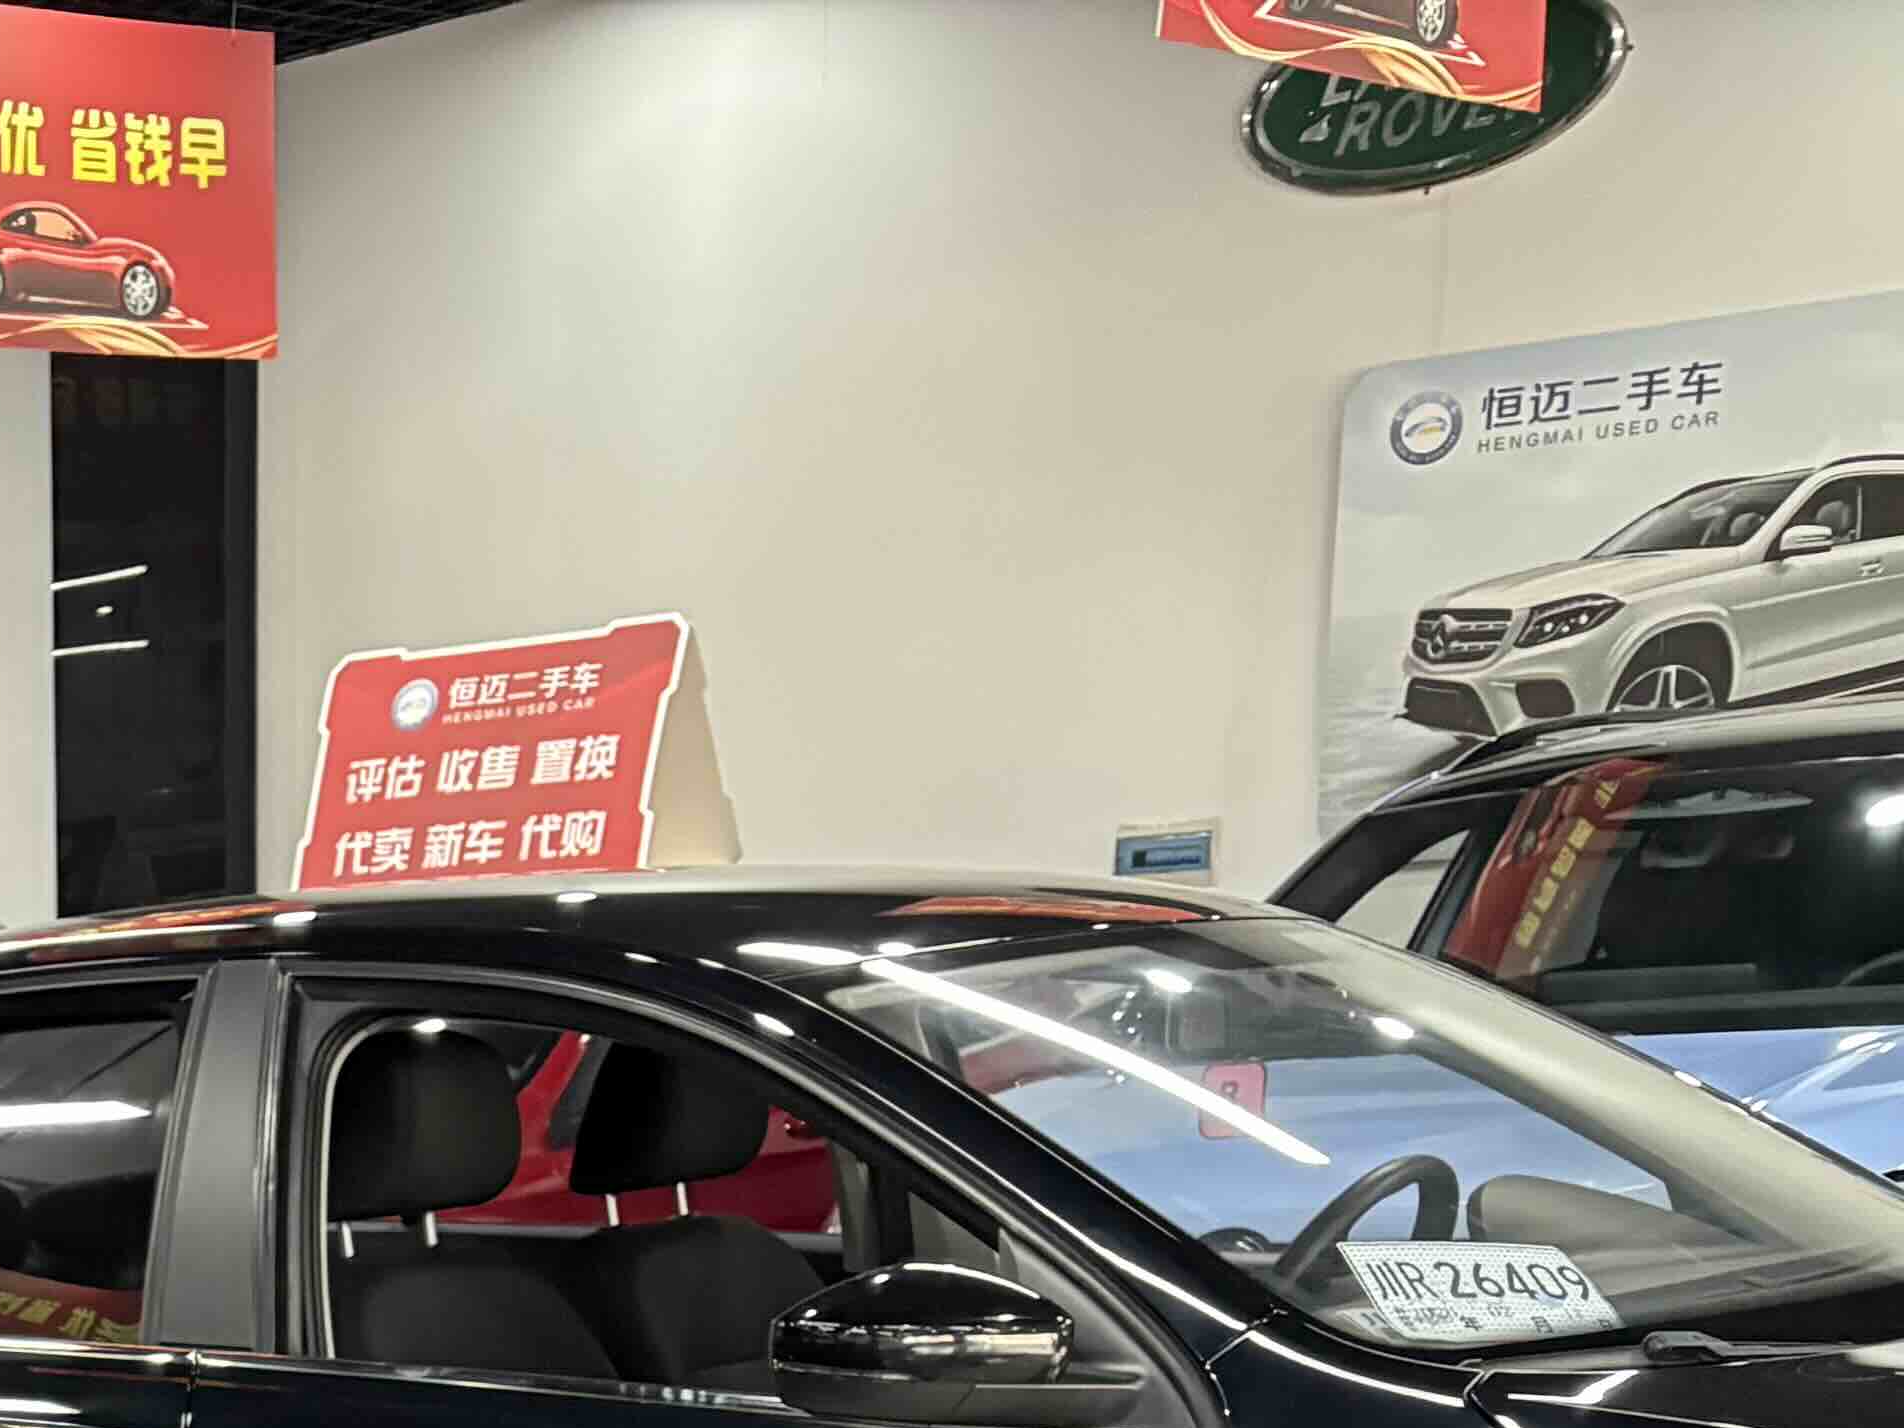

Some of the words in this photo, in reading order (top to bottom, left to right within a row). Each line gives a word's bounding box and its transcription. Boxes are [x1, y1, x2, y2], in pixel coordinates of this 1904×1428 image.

[71, 107, 227, 190] 省钱早
[1333, 93, 1514, 157] ROVE
[1481, 361, 1723, 430] 恒迈二手车
[1477, 427, 1584, 454] HENGMAI
[1595, 418, 1659, 440] USED
[1671, 411, 1720, 431] CAR
[449, 662, 604, 709] 恒迈二手车
[346, 754, 426, 804] 评估
[437, 744, 522, 794] 收售
[530, 734, 621, 785] 置换
[333, 827, 415, 878] 代卖
[421, 819, 508, 870] 新车
[519, 809, 608, 861] 代购
